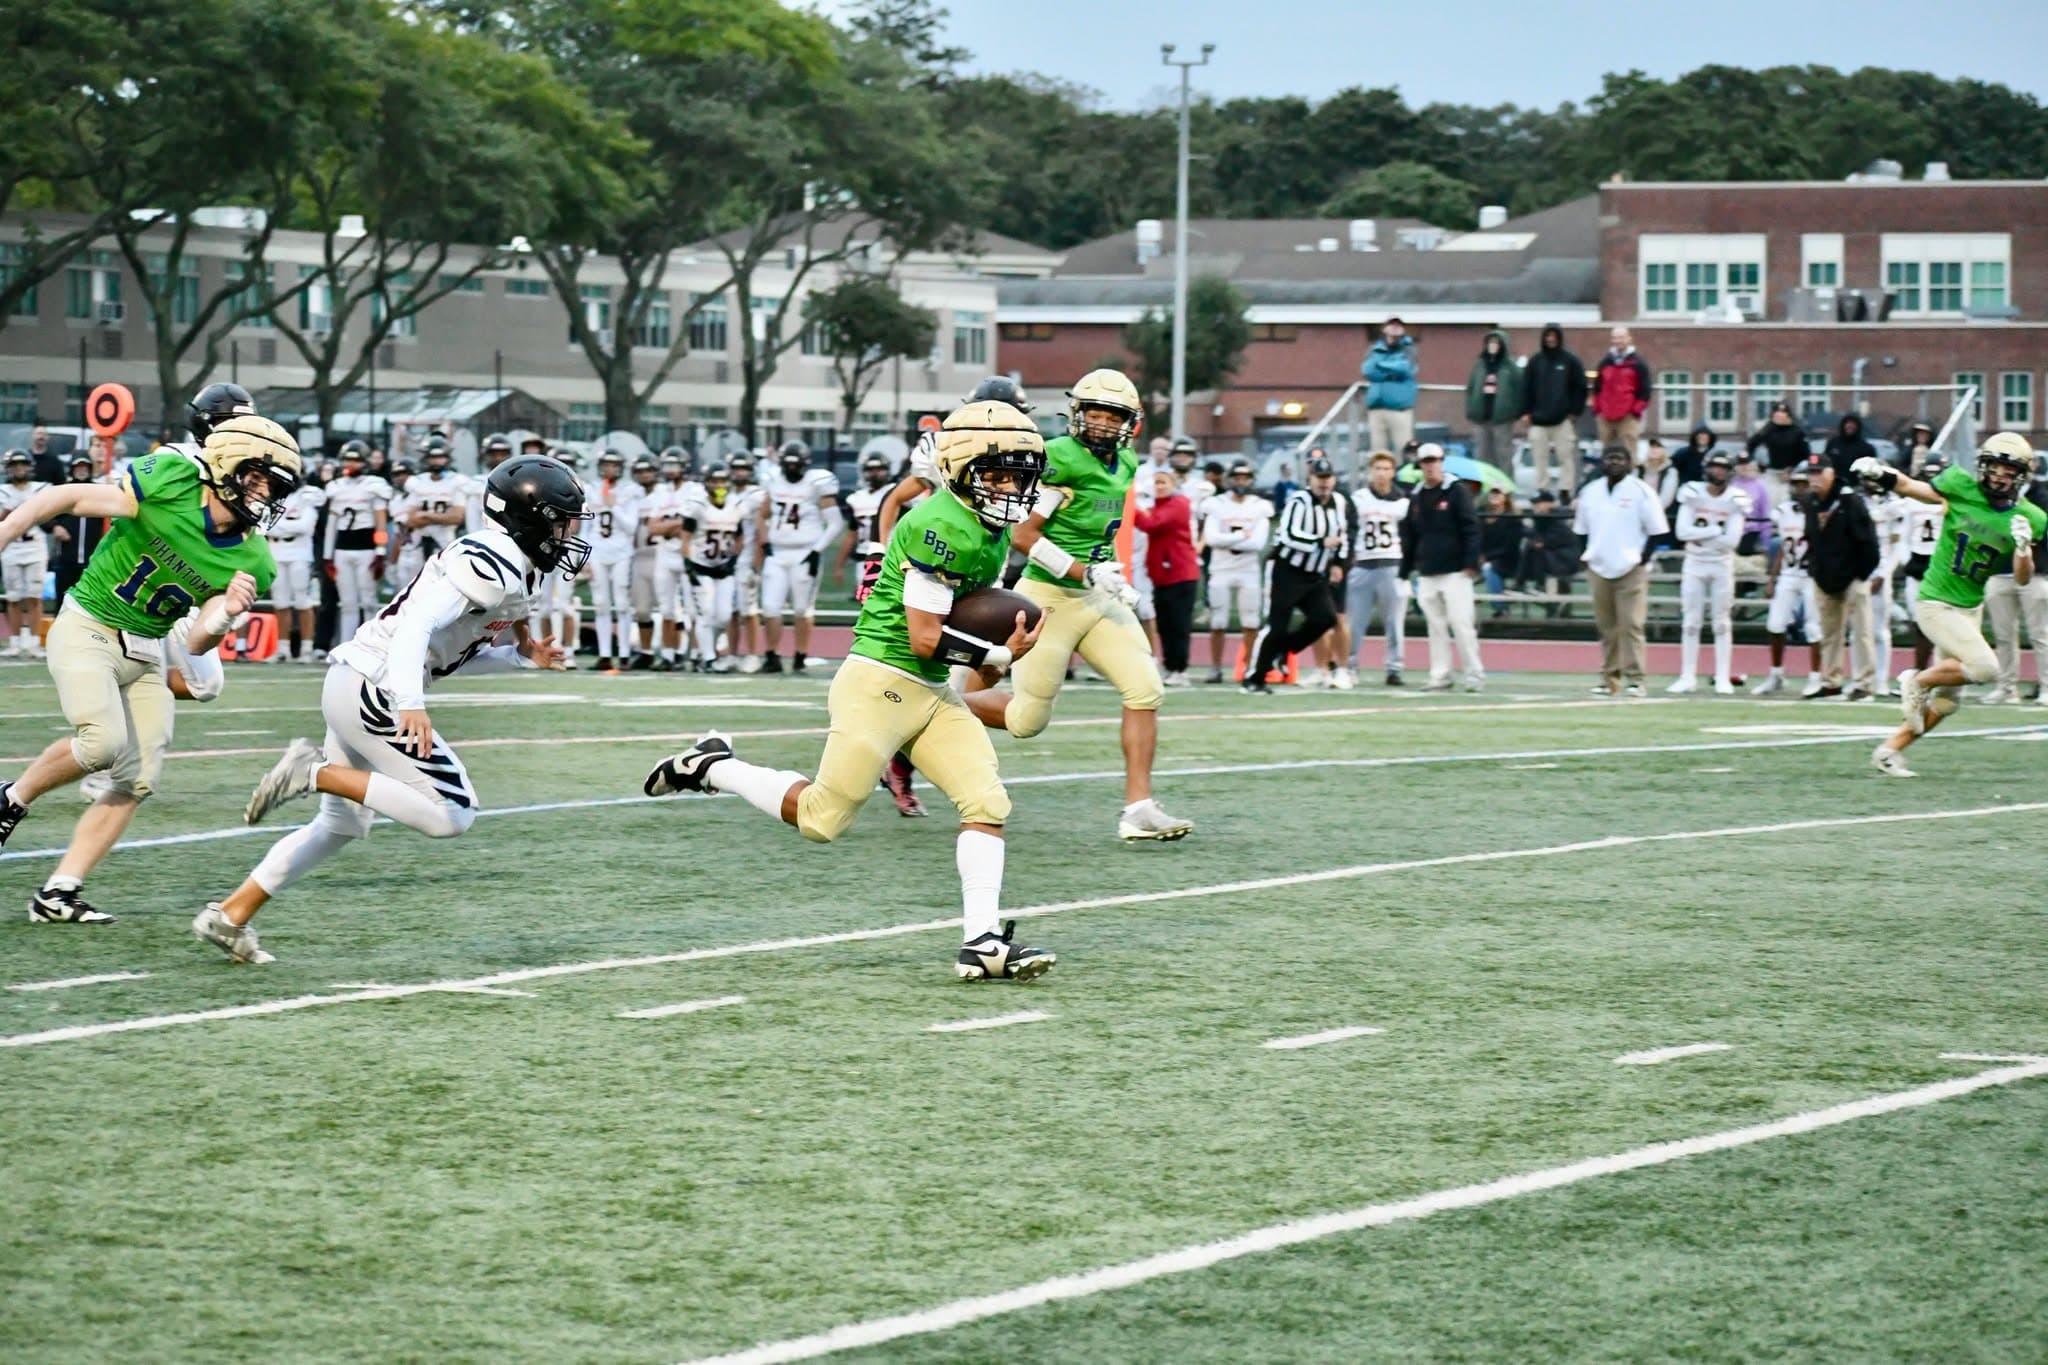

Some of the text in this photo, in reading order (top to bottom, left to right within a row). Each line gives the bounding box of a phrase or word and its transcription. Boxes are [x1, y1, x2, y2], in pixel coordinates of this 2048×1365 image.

[600, 511, 614, 538] 9
[775, 501, 800, 530] 74
[1921, 519, 1936, 542] 1
[923, 528, 957, 565] BBP
[1951, 531, 2001, 585] 12
[147, 535, 216, 600] PHANTOM
[224, 616, 264, 653] 0
